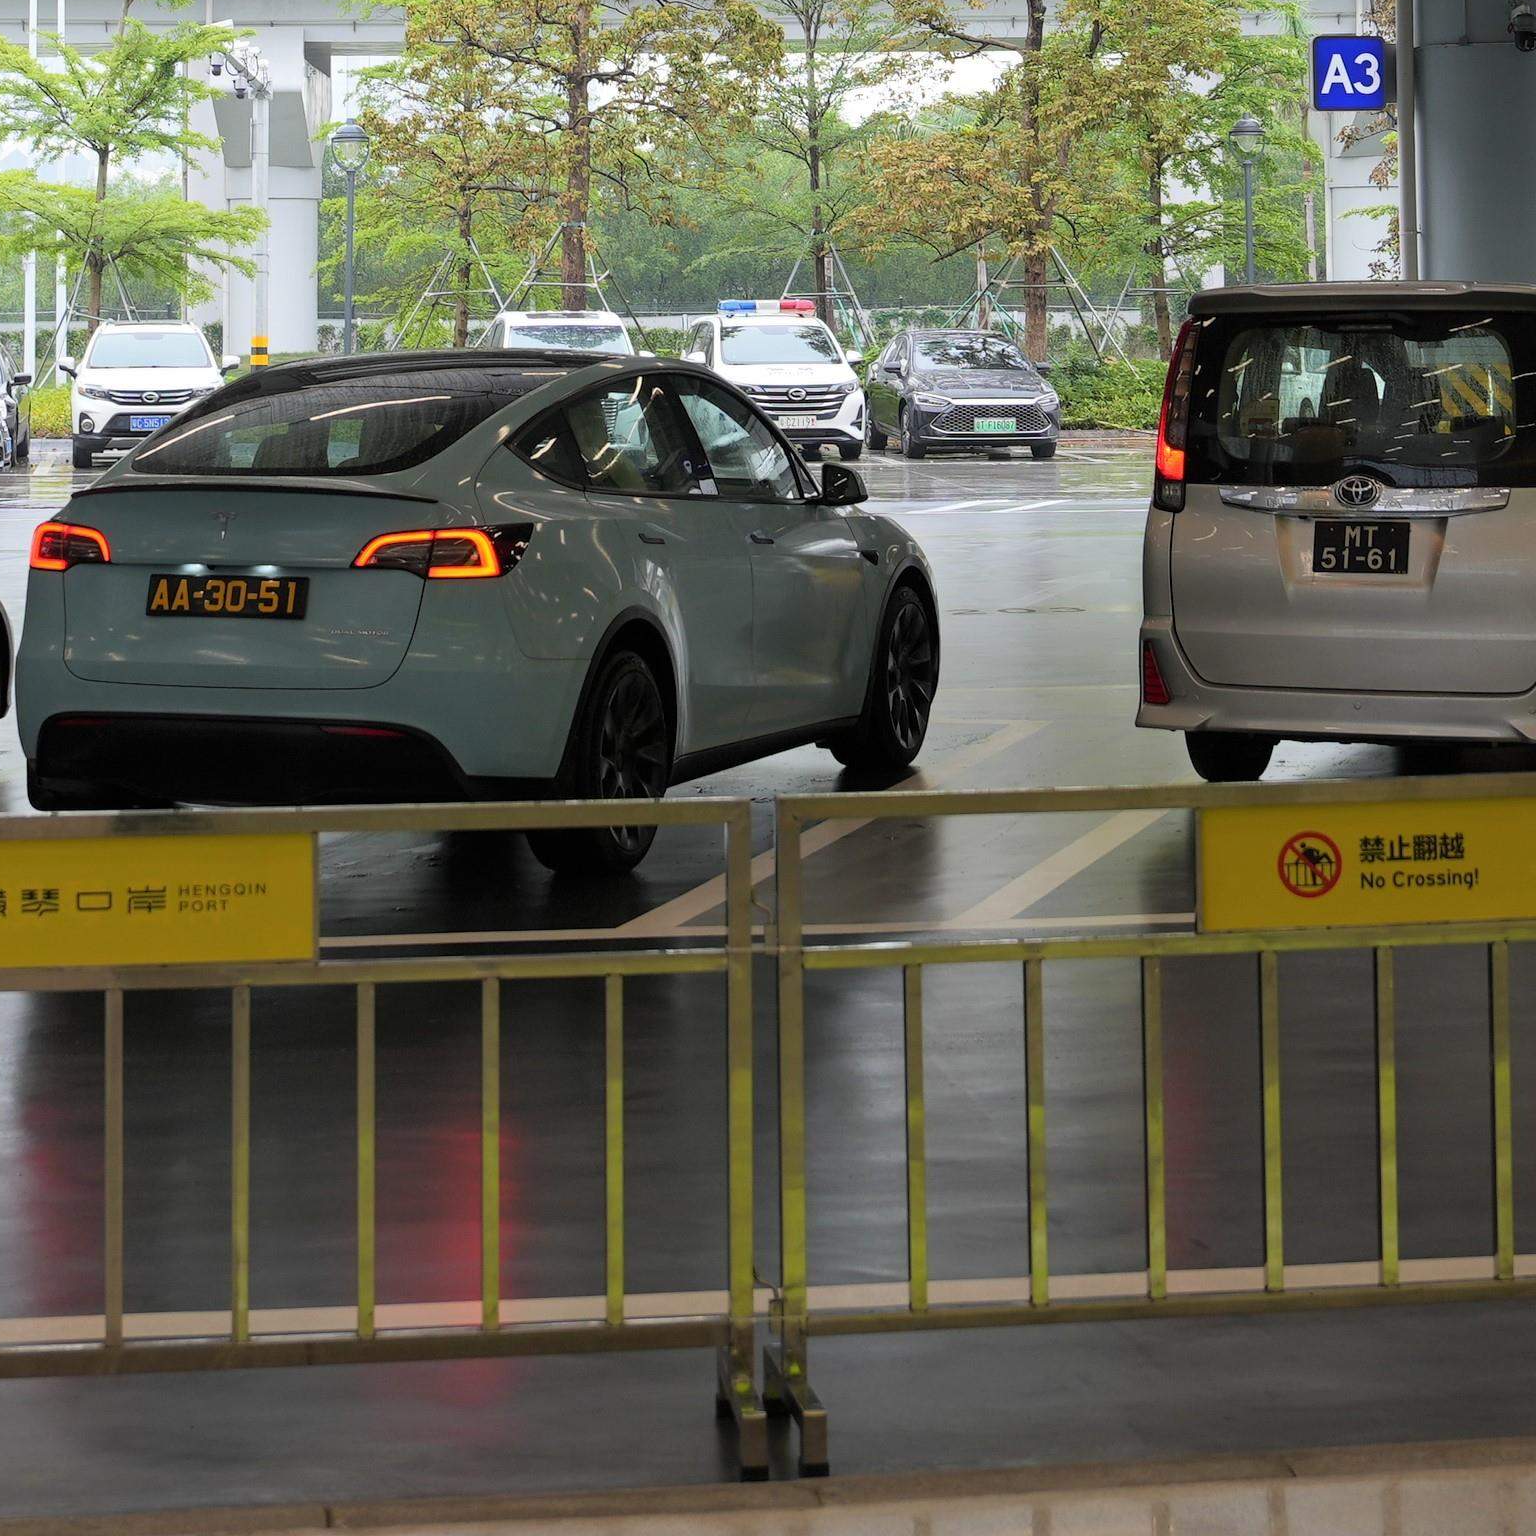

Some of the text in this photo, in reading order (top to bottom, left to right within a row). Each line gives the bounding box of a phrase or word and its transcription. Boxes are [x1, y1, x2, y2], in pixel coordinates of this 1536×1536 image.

[1320, 52, 1381, 95] A3
[1344, 525, 1378, 547] MT
[1321, 547, 1396, 570] 51-61
[150, 578, 297, 614] AA-30-51
[1359, 832, 1465, 863] 禁止翻越
[177, 882, 267, 896] HENGQIN
[1360, 868, 1479, 890] No Crossing!
[178, 899, 229, 913] PORT
